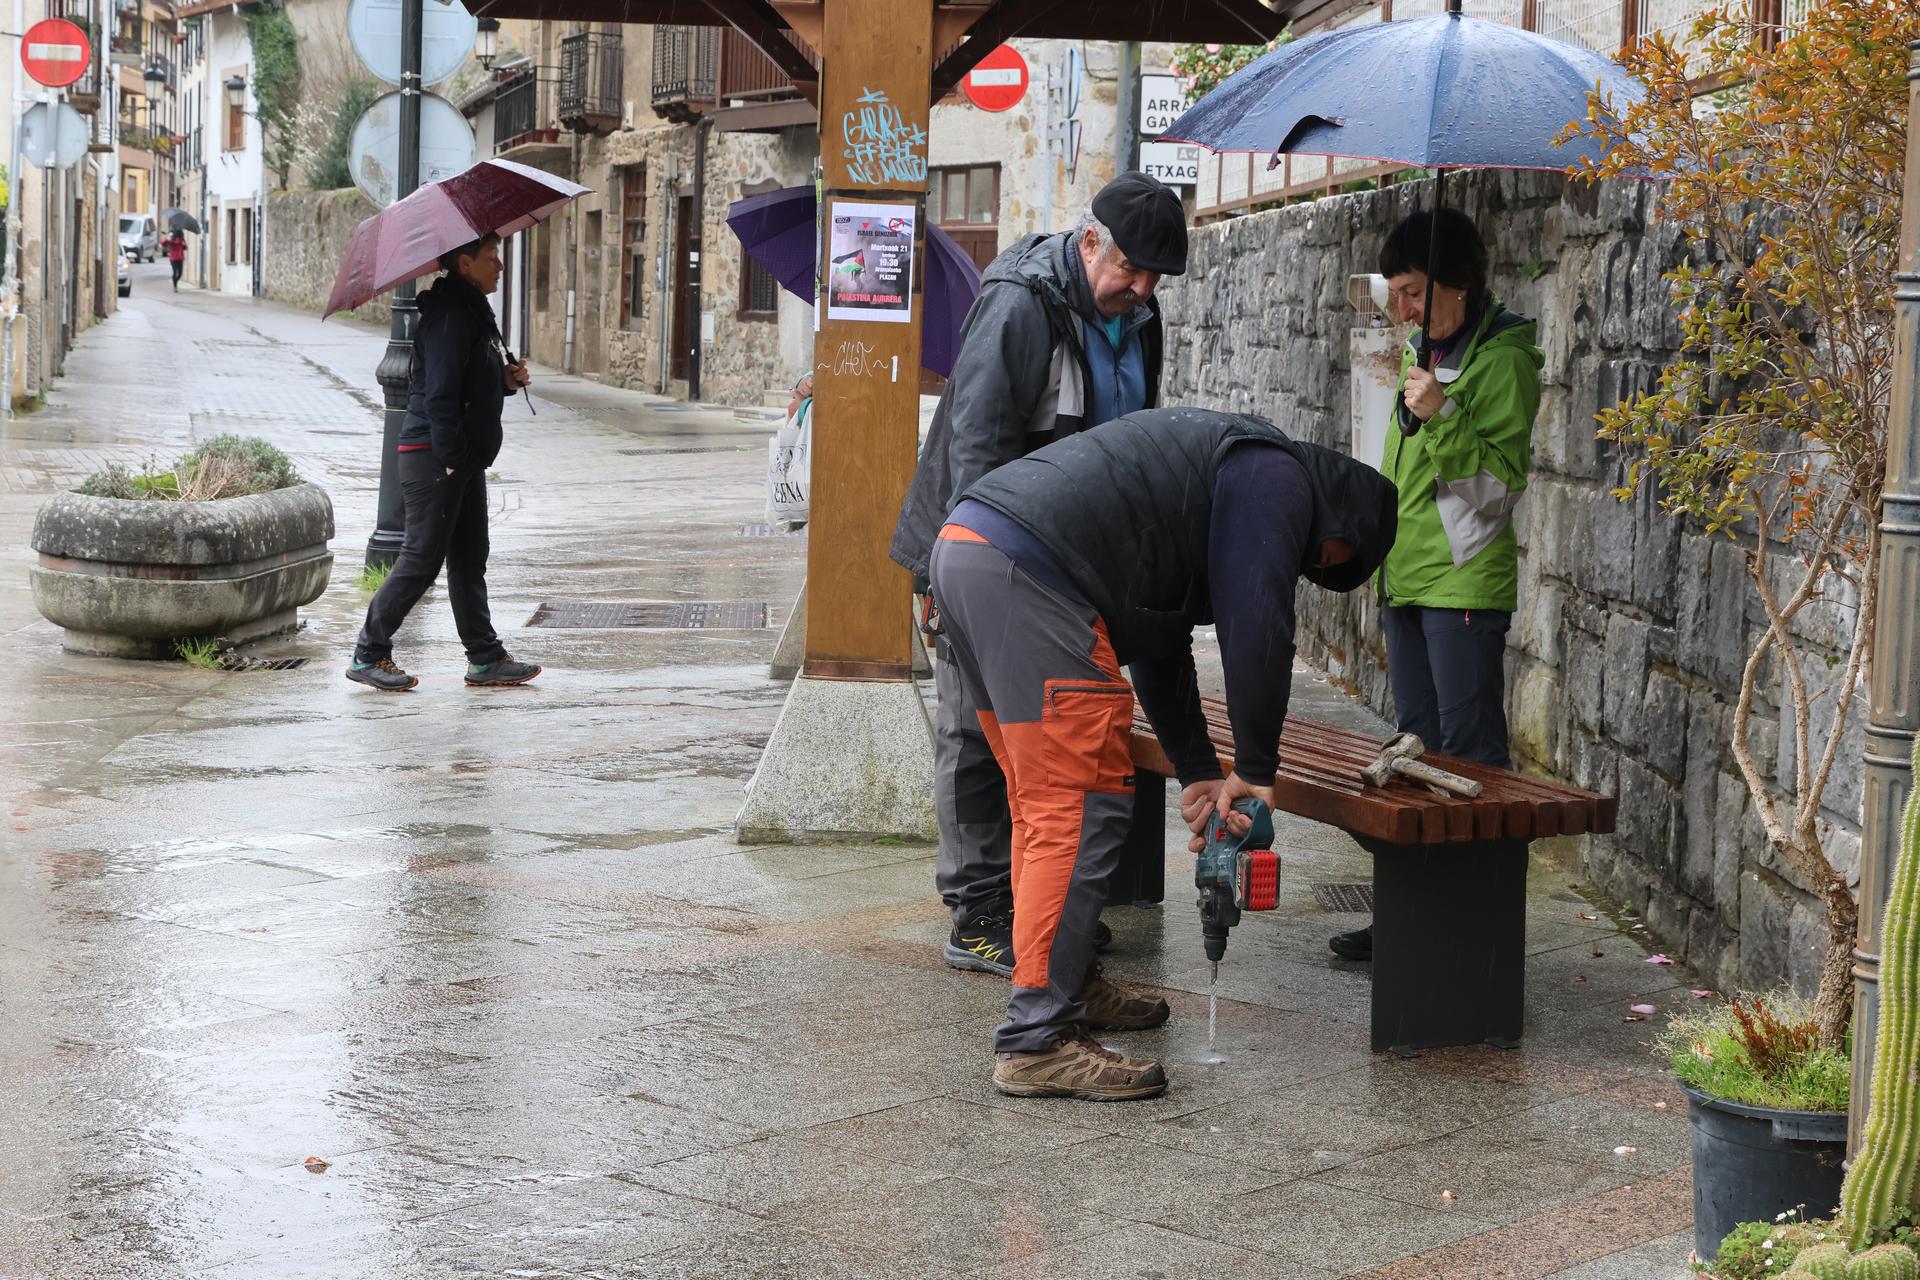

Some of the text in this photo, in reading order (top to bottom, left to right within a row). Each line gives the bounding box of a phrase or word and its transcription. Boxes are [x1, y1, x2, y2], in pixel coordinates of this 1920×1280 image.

[900, 245, 908, 253] 21
[837, 293, 871, 302] PALESTINA
[872, 294, 902, 304] AURRERA
